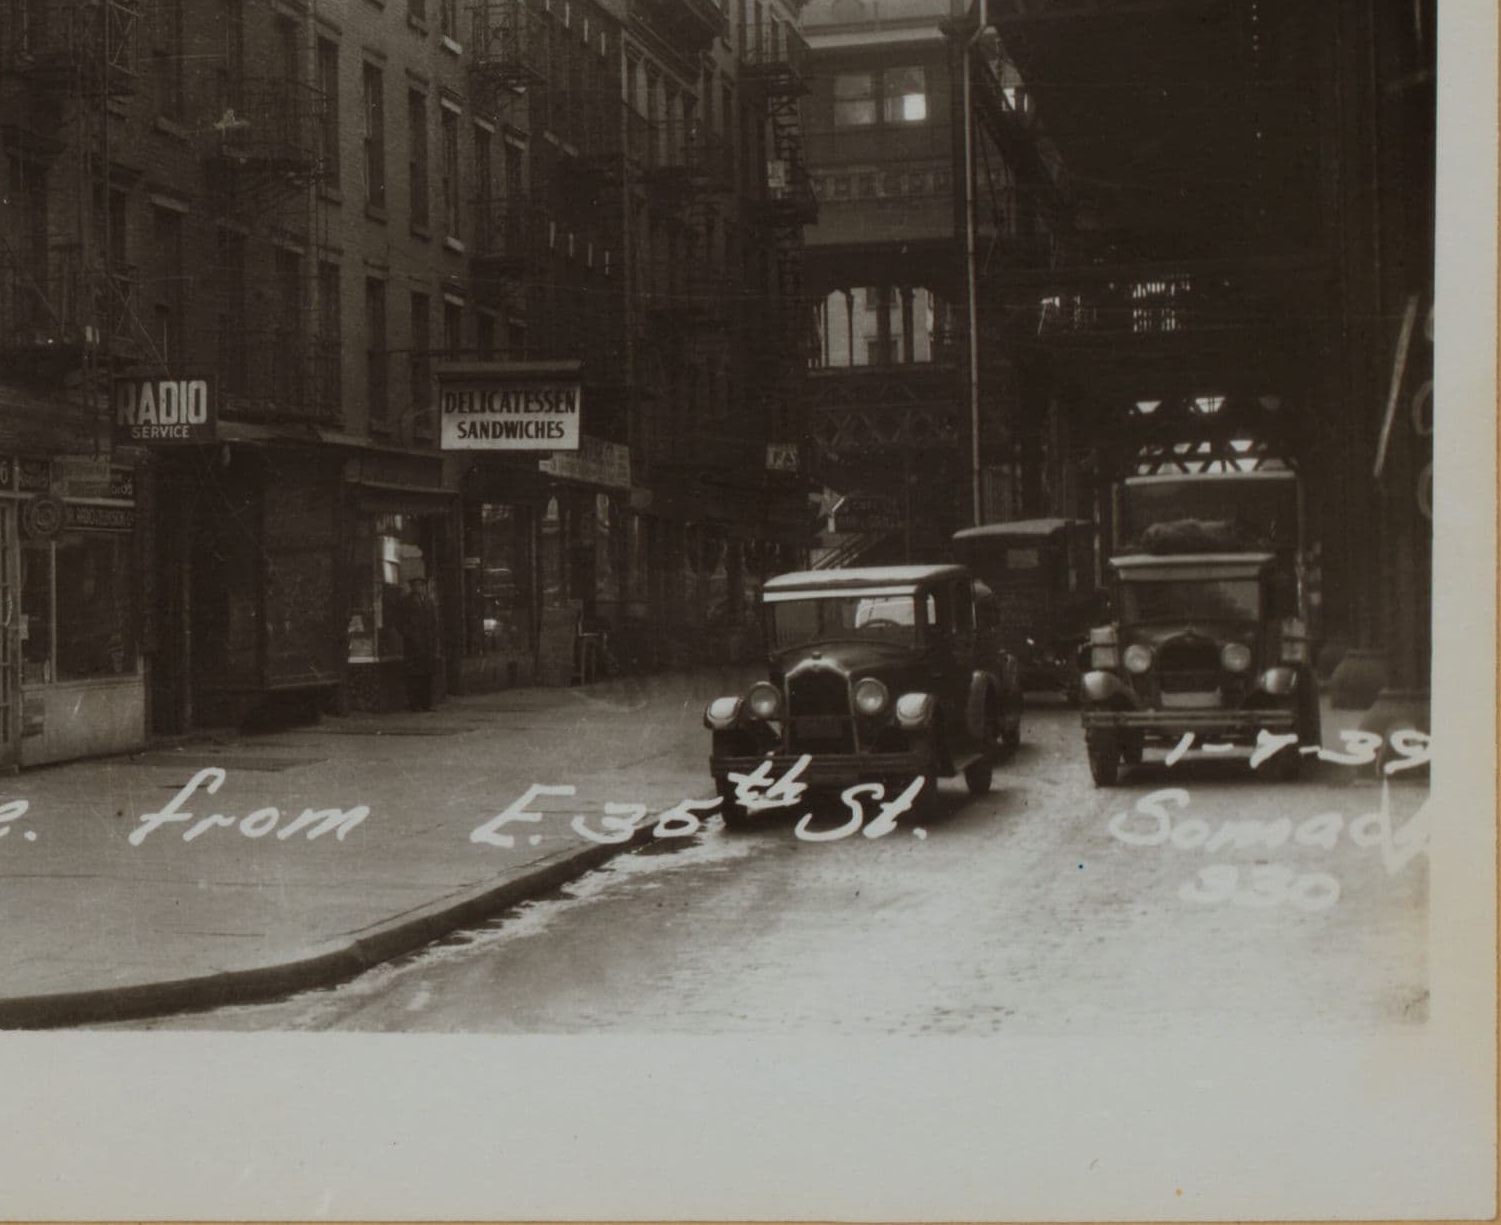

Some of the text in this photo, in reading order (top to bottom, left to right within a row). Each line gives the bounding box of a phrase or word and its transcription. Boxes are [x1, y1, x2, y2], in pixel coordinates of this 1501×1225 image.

[116, 379, 208, 426] RADIO
[444, 389, 577, 414] DELICATESSEN
[131, 424, 191, 439] SERVICE
[457, 420, 565, 440] SANDWICHES
